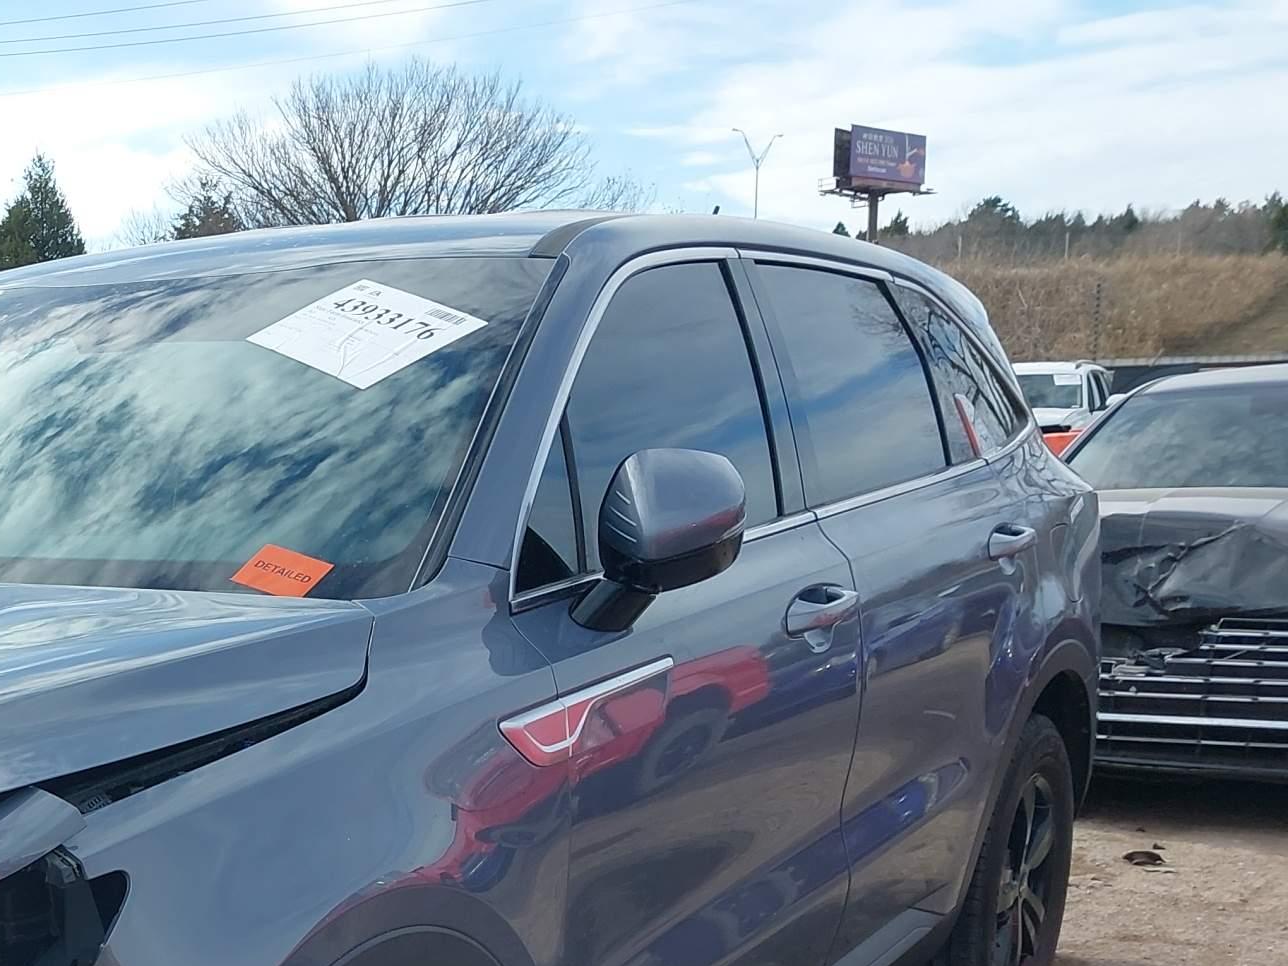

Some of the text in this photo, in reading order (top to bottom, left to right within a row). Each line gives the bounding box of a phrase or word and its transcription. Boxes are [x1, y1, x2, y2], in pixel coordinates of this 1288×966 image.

[855, 139, 880, 156] SHEN
[881, 143, 899, 159] YUN
[333, 297, 437, 341] 43933176
[254, 560, 312, 584] DETAILED
